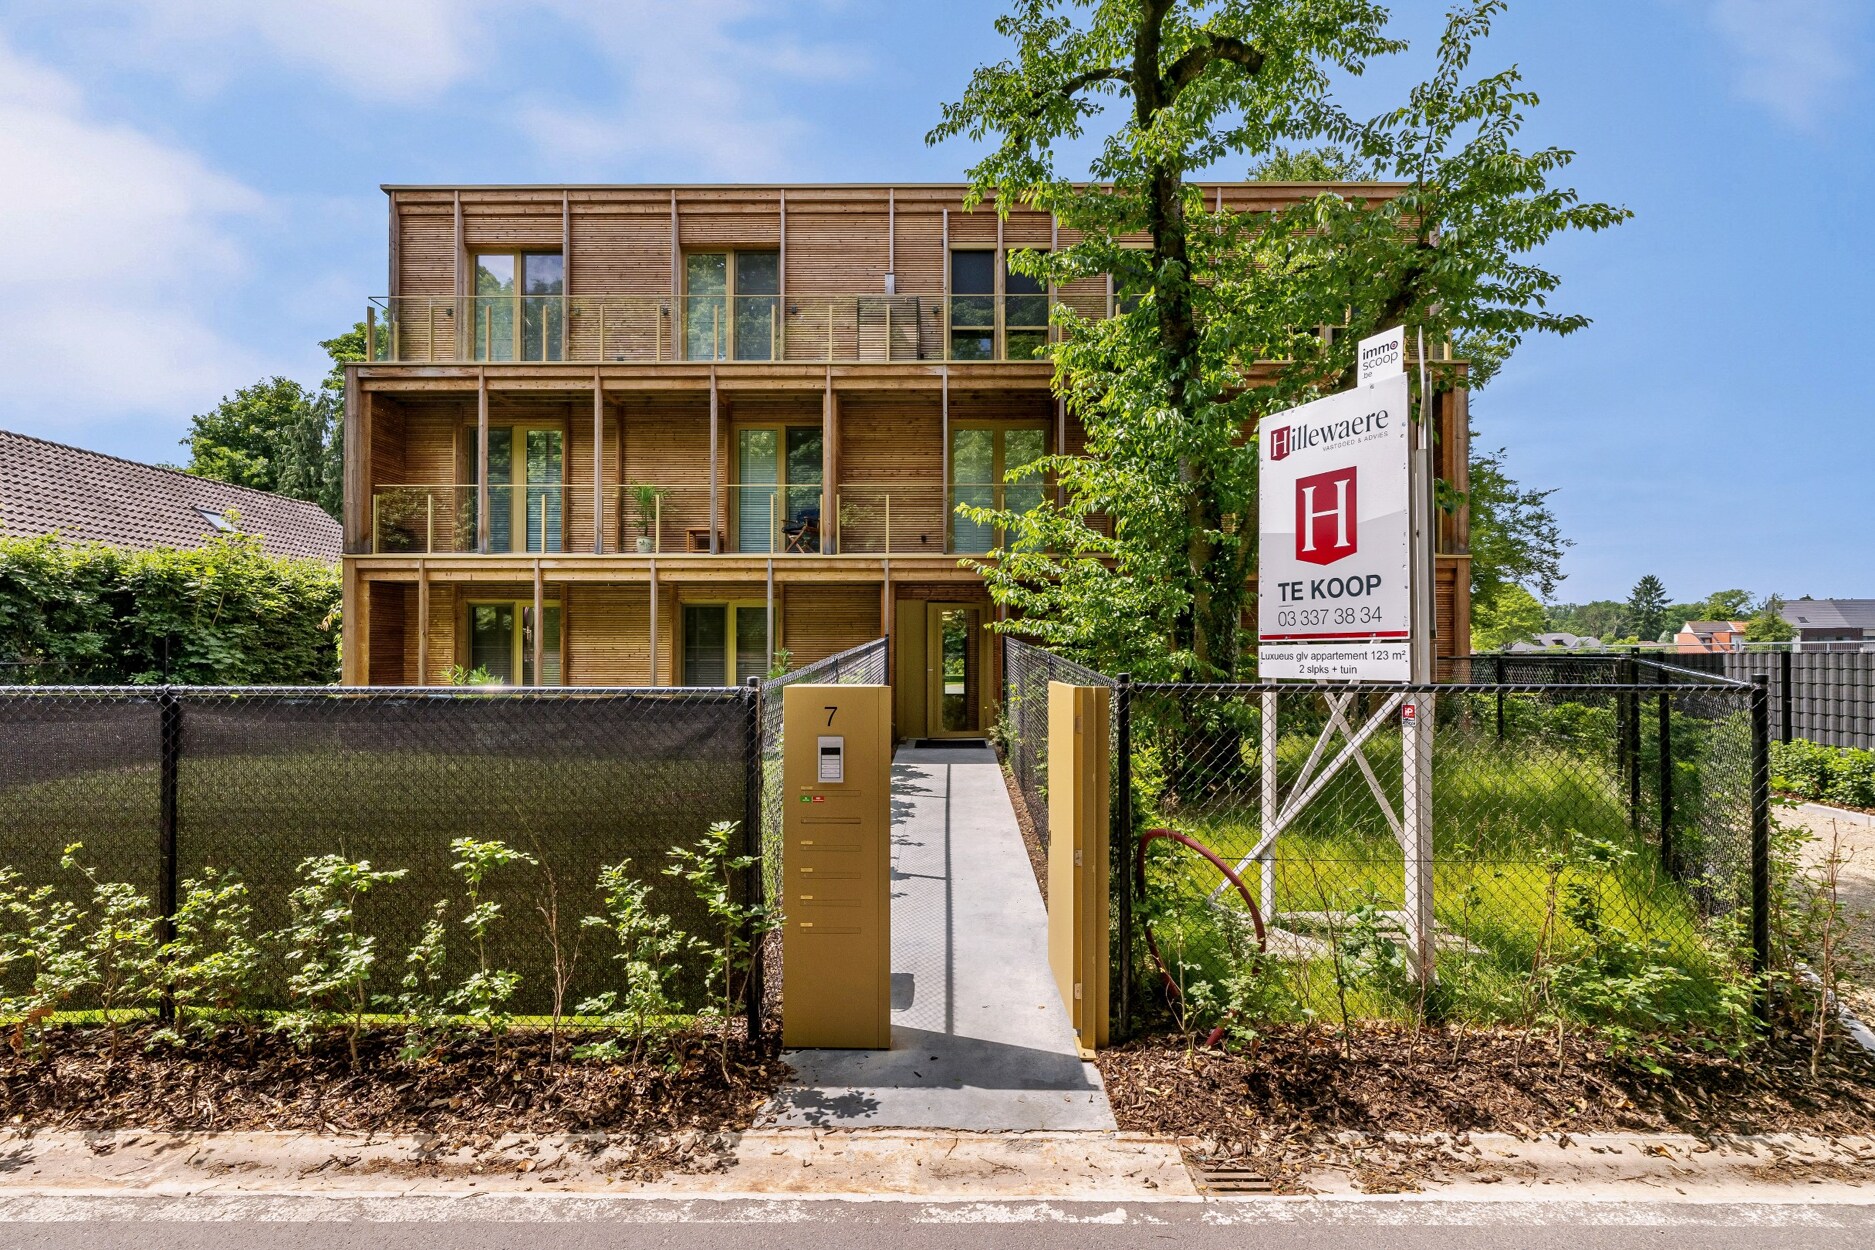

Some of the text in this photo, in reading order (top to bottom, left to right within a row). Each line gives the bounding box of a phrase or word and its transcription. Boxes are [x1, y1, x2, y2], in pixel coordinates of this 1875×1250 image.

[1363, 340, 1398, 360] immo
[1363, 351, 1398, 371] scoop
[1272, 409, 1389, 458] Hillewaere
[1323, 439, 1355, 452] VASTGOED
[1363, 431, 1389, 442] ADVIES
[1301, 478, 1351, 552] H
[1277, 574, 1382, 601] TE KOOP
[1277, 605, 1383, 627] 03 337 38 34
[1260, 650, 1407, 662] Luxueus glv appartement 123 m²
[1299, 664, 1305, 674] 2
[1306, 664, 1330, 676] slpks
[1340, 664, 1358, 675] tuin
[824, 706, 838, 727] 7
